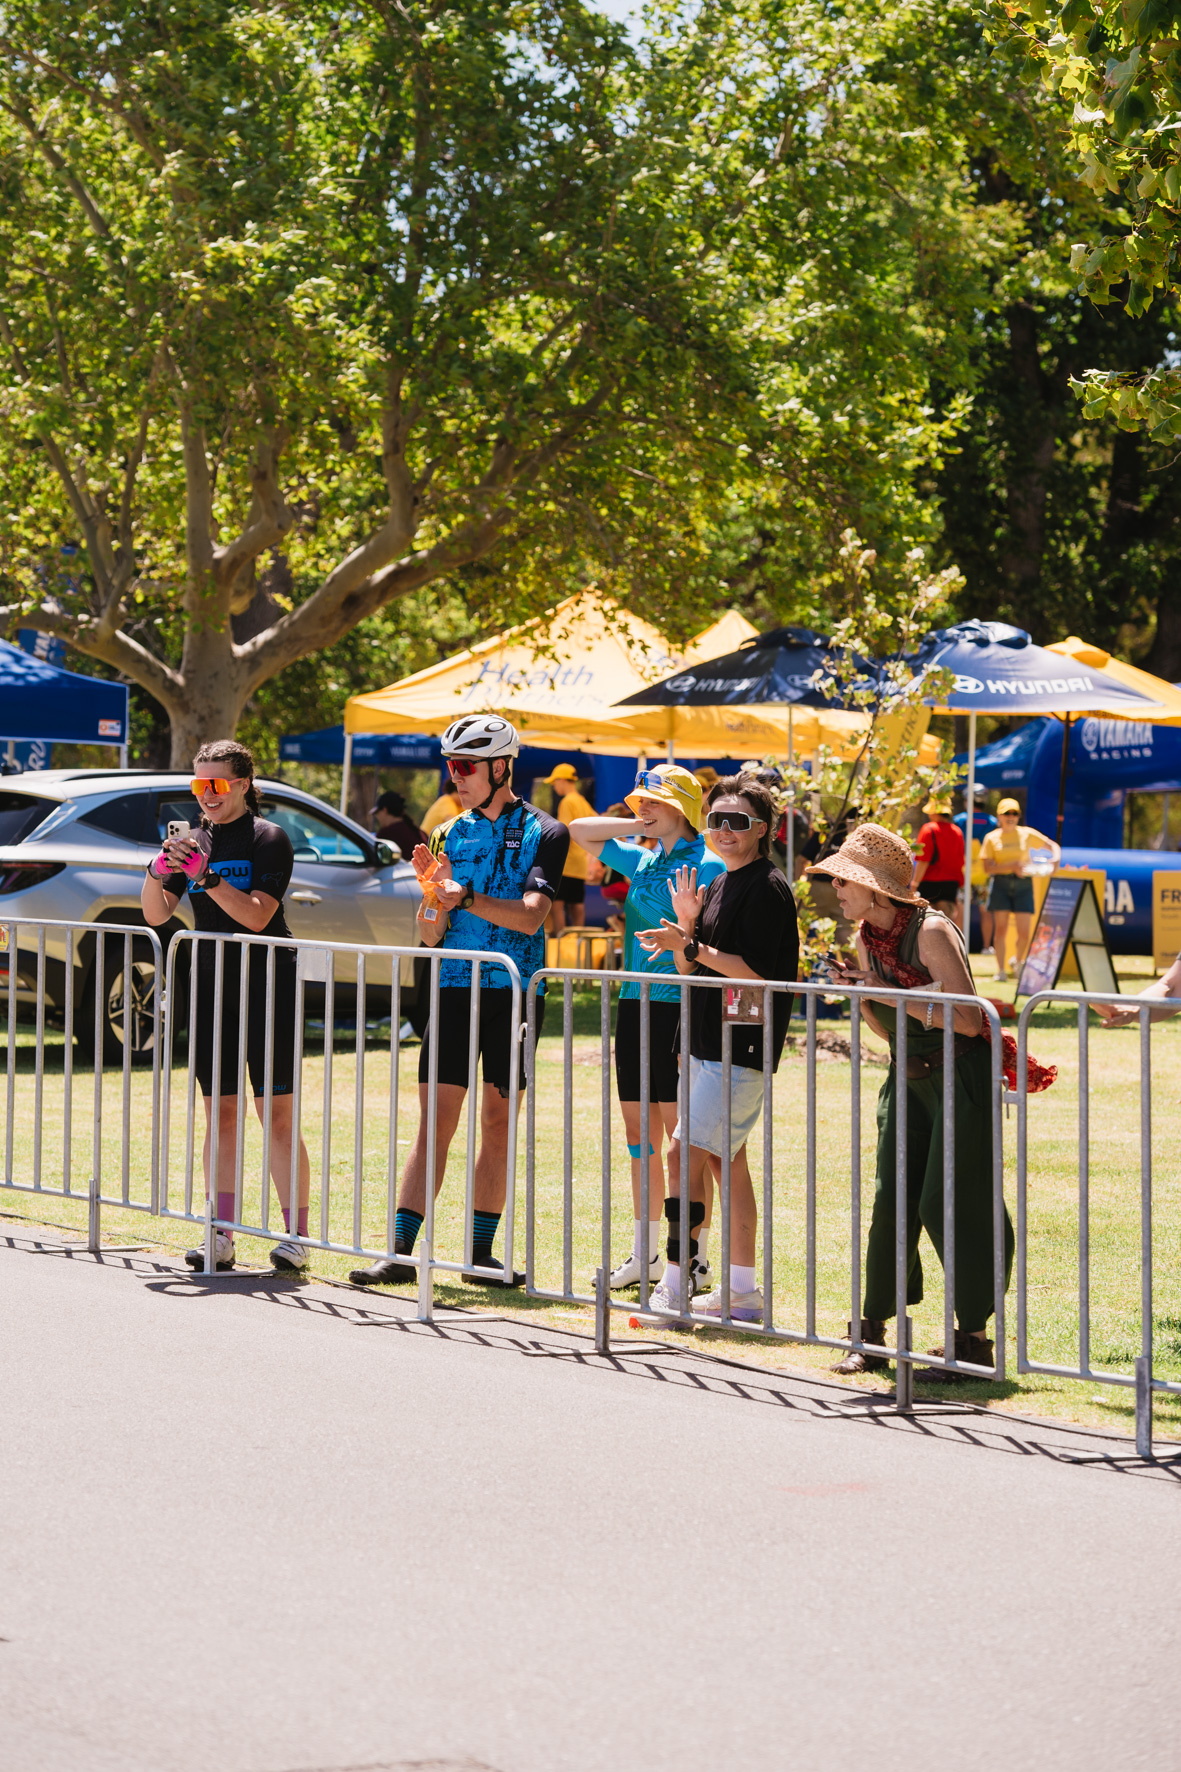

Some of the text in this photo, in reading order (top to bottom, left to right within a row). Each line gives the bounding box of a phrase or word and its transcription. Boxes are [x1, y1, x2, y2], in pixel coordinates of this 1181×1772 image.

[475, 661, 594, 686] Health
[986, 676, 1094, 695] HYUNDAI
[1098, 718, 1154, 748] YAMAHA
[1089, 748, 1152, 760] RACING
[505, 840, 520, 848] TAC
